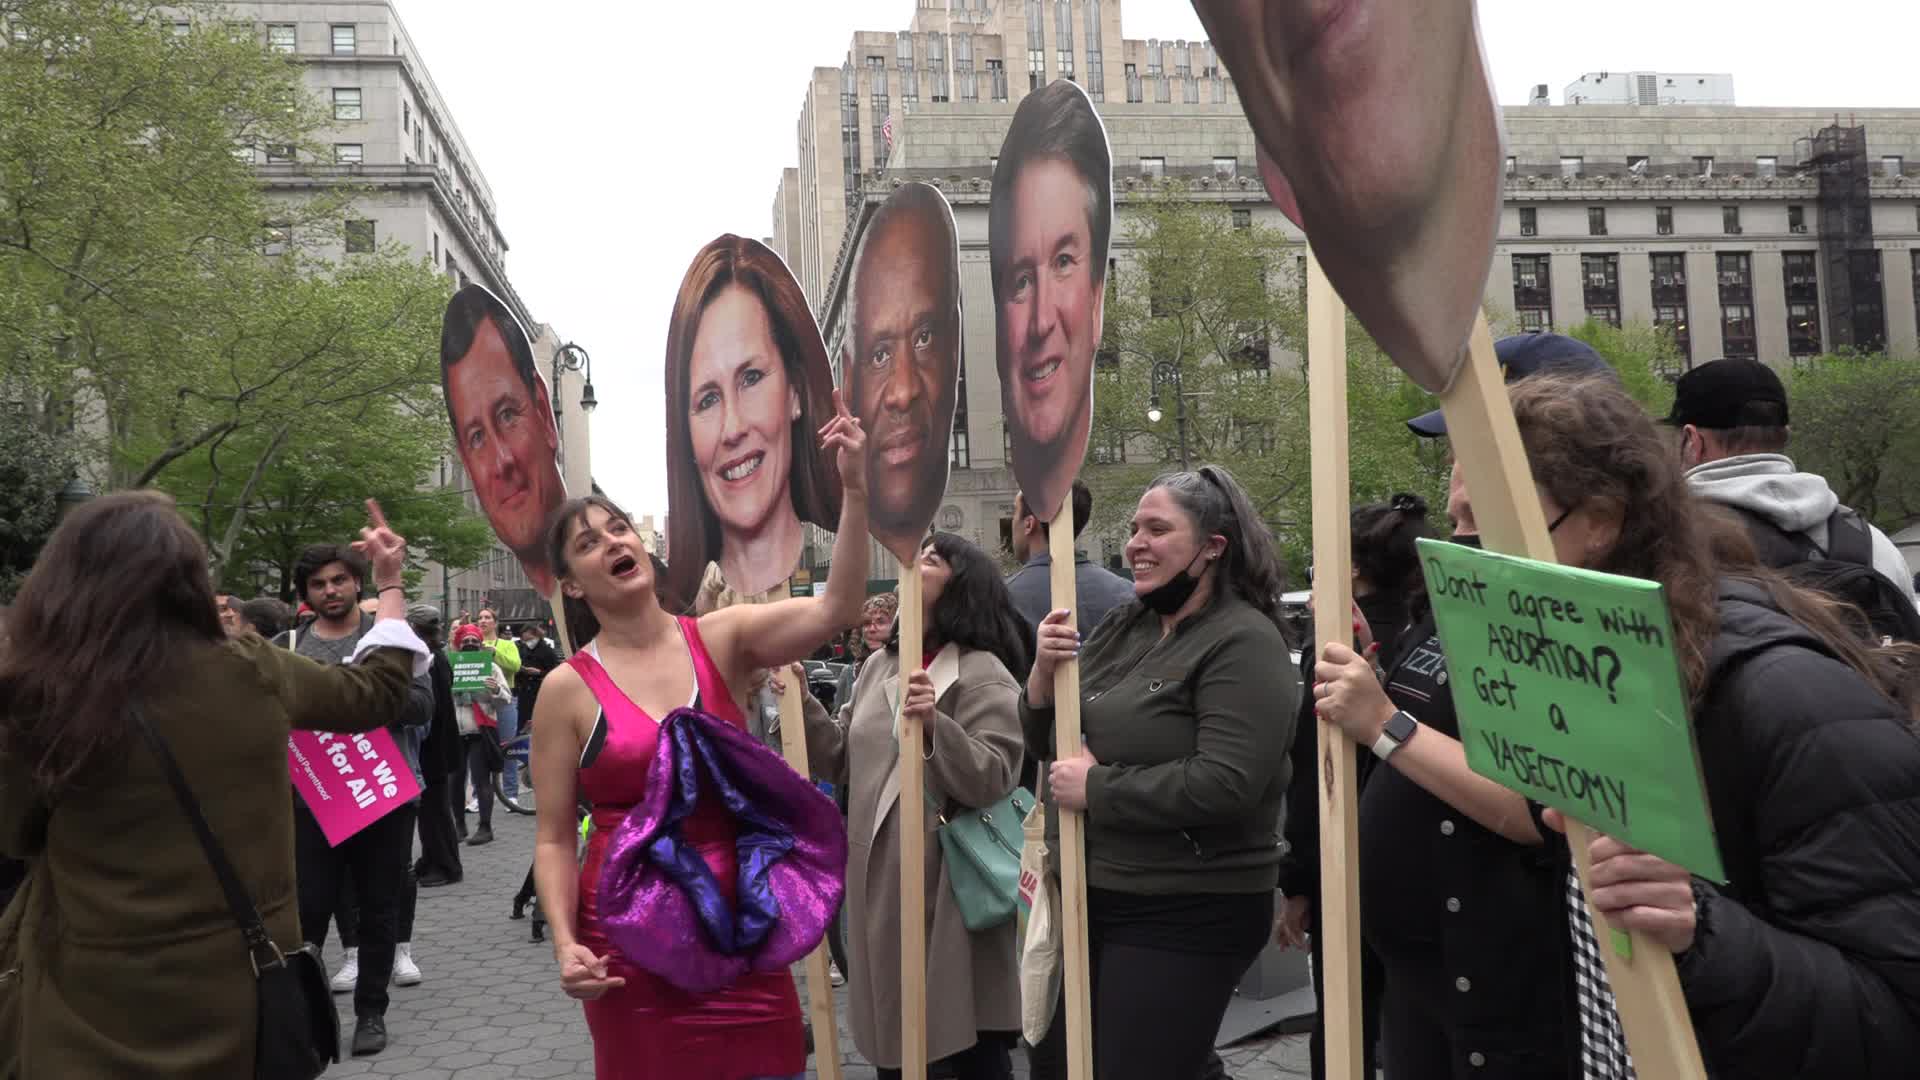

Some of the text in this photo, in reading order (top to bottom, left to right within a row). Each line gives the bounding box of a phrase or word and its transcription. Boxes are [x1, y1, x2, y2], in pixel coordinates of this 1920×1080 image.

[1427, 557, 1665, 647] Dont agree with
[1487, 623, 1622, 704] ABORTION?
[1473, 666, 1570, 735] Get a
[302, 760, 330, 800] Parenthood
[325, 742, 354, 775] for
[345, 778, 377, 809] All
[372, 760, 398, 798] We
[1480, 729, 1629, 827] VASECTOMY
